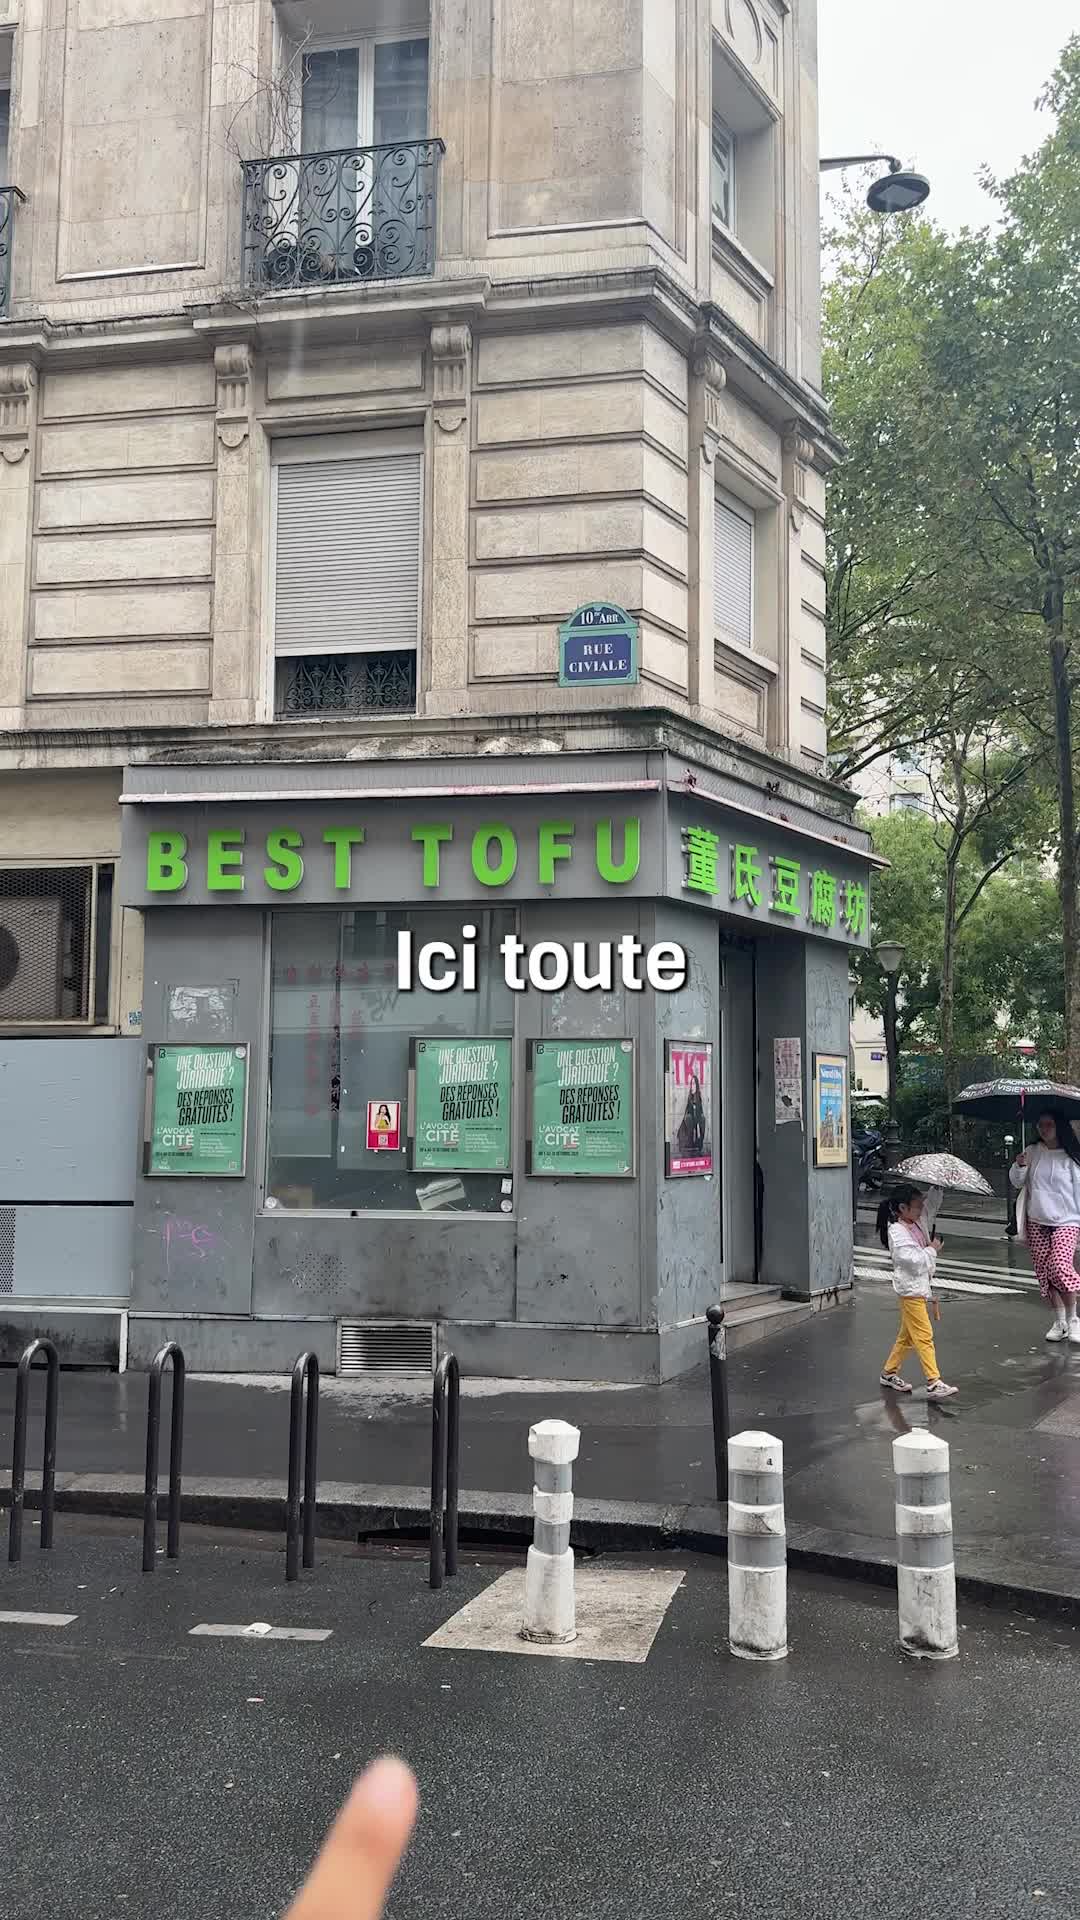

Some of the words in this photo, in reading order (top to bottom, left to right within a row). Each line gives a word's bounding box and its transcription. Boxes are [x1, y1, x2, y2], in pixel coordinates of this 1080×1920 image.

[583, 643, 613, 655] RUE
[568, 659, 627, 673] CIVIALE
[146, 828, 365, 892] BEST
[411, 816, 641, 888] TOFU
[681, 825, 866, 935] 董氏豆腐坊
[194, 1051, 233, 1069] QUESTION
[455, 1044, 496, 1064] QUESTION
[575, 1046, 616, 1066] QUESTION
[176, 1069, 227, 1090] JURIDIQUE
[227, 1067, 235, 1086] ?
[439, 1062, 490, 1084] JURIDIQUE
[491, 1060, 499, 1079] ?
[558, 1064, 610, 1087] JURIDIQUE
[611, 1062, 619, 1082] ?
[671, 1050, 708, 1087] TKT
[177, 1091, 193, 1107] DES
[440, 1085, 456, 1103] DES
[559, 1087, 576, 1106] DES
[178, 1104, 228, 1126] GRATUITES
[442, 1099, 494, 1121] GRATUITES
[562, 1101, 615, 1125] GRATUITES
